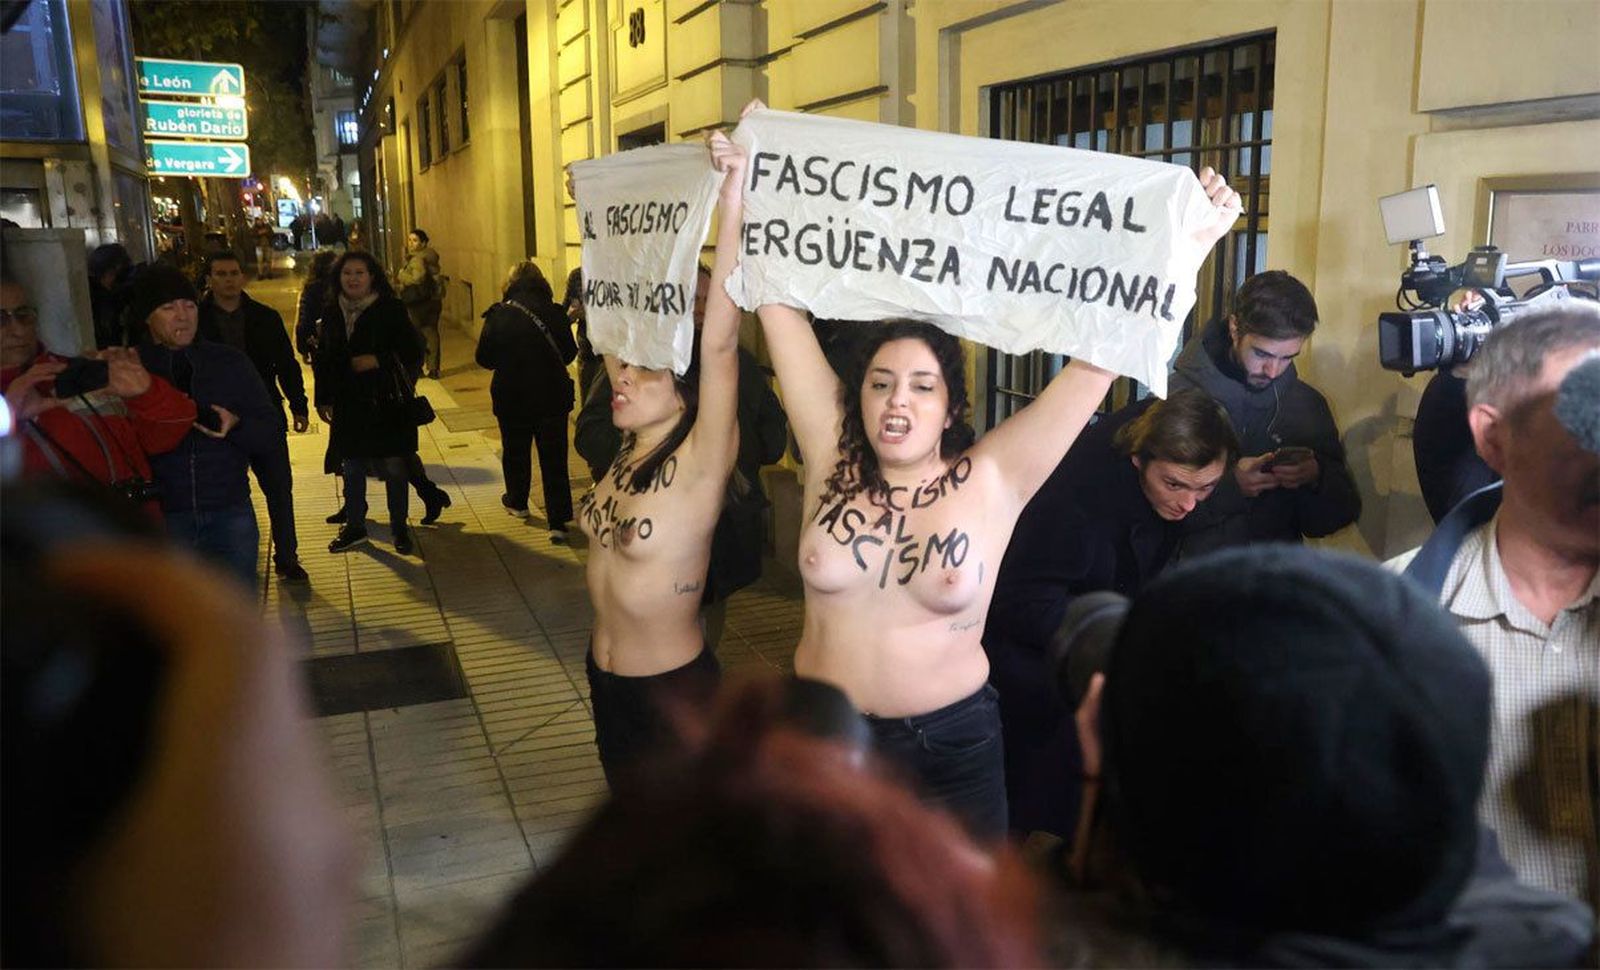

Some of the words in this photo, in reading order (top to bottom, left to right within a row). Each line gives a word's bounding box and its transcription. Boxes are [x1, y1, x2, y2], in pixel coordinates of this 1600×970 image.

[153, 74, 192, 89] León
[177, 108, 224, 119] glorieta
[226, 110, 241, 120] de
[146, 117, 197, 132] Rubén
[146, 157, 162, 169] de
[164, 157, 215, 171] Vergara
[750, 151, 975, 217] FASCISMO
[1003, 185, 1148, 233] LEGAL
[606, 201, 689, 237] FASCISMO
[1542, 243, 1568, 256] LOS
[986, 255, 1176, 322] NACIONAL
[873, 510, 914, 544] AL
